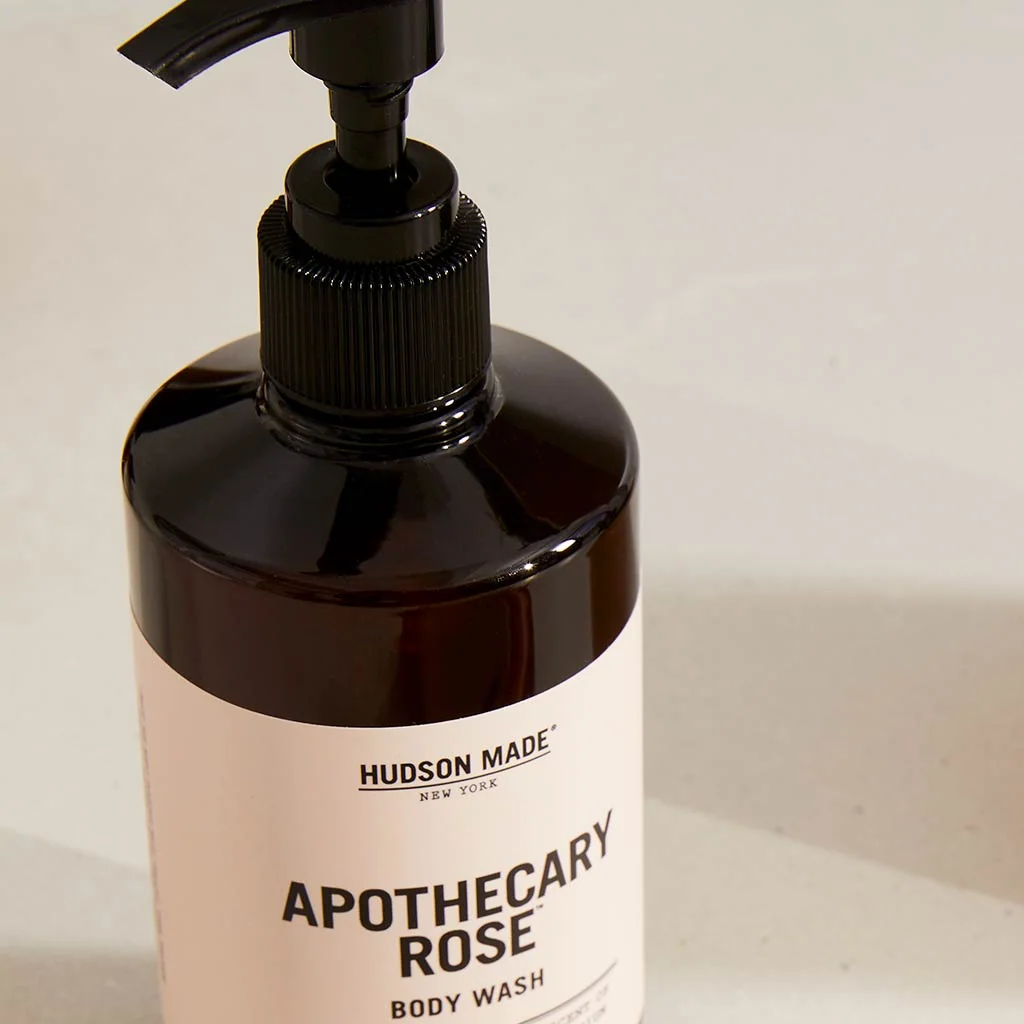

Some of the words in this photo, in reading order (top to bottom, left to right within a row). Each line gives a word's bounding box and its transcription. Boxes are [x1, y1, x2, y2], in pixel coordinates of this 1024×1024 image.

[360, 754, 471, 785] HUDSON
[482, 728, 549, 770] MADE
[419, 789, 451, 801] NEW
[460, 778, 498, 796] YORK
[282, 808, 613, 932] APOTHECARY
[400, 909, 536, 978] ROSE
[391, 993, 461, 1020] BODY
[472, 968, 544, 1008] WASH
